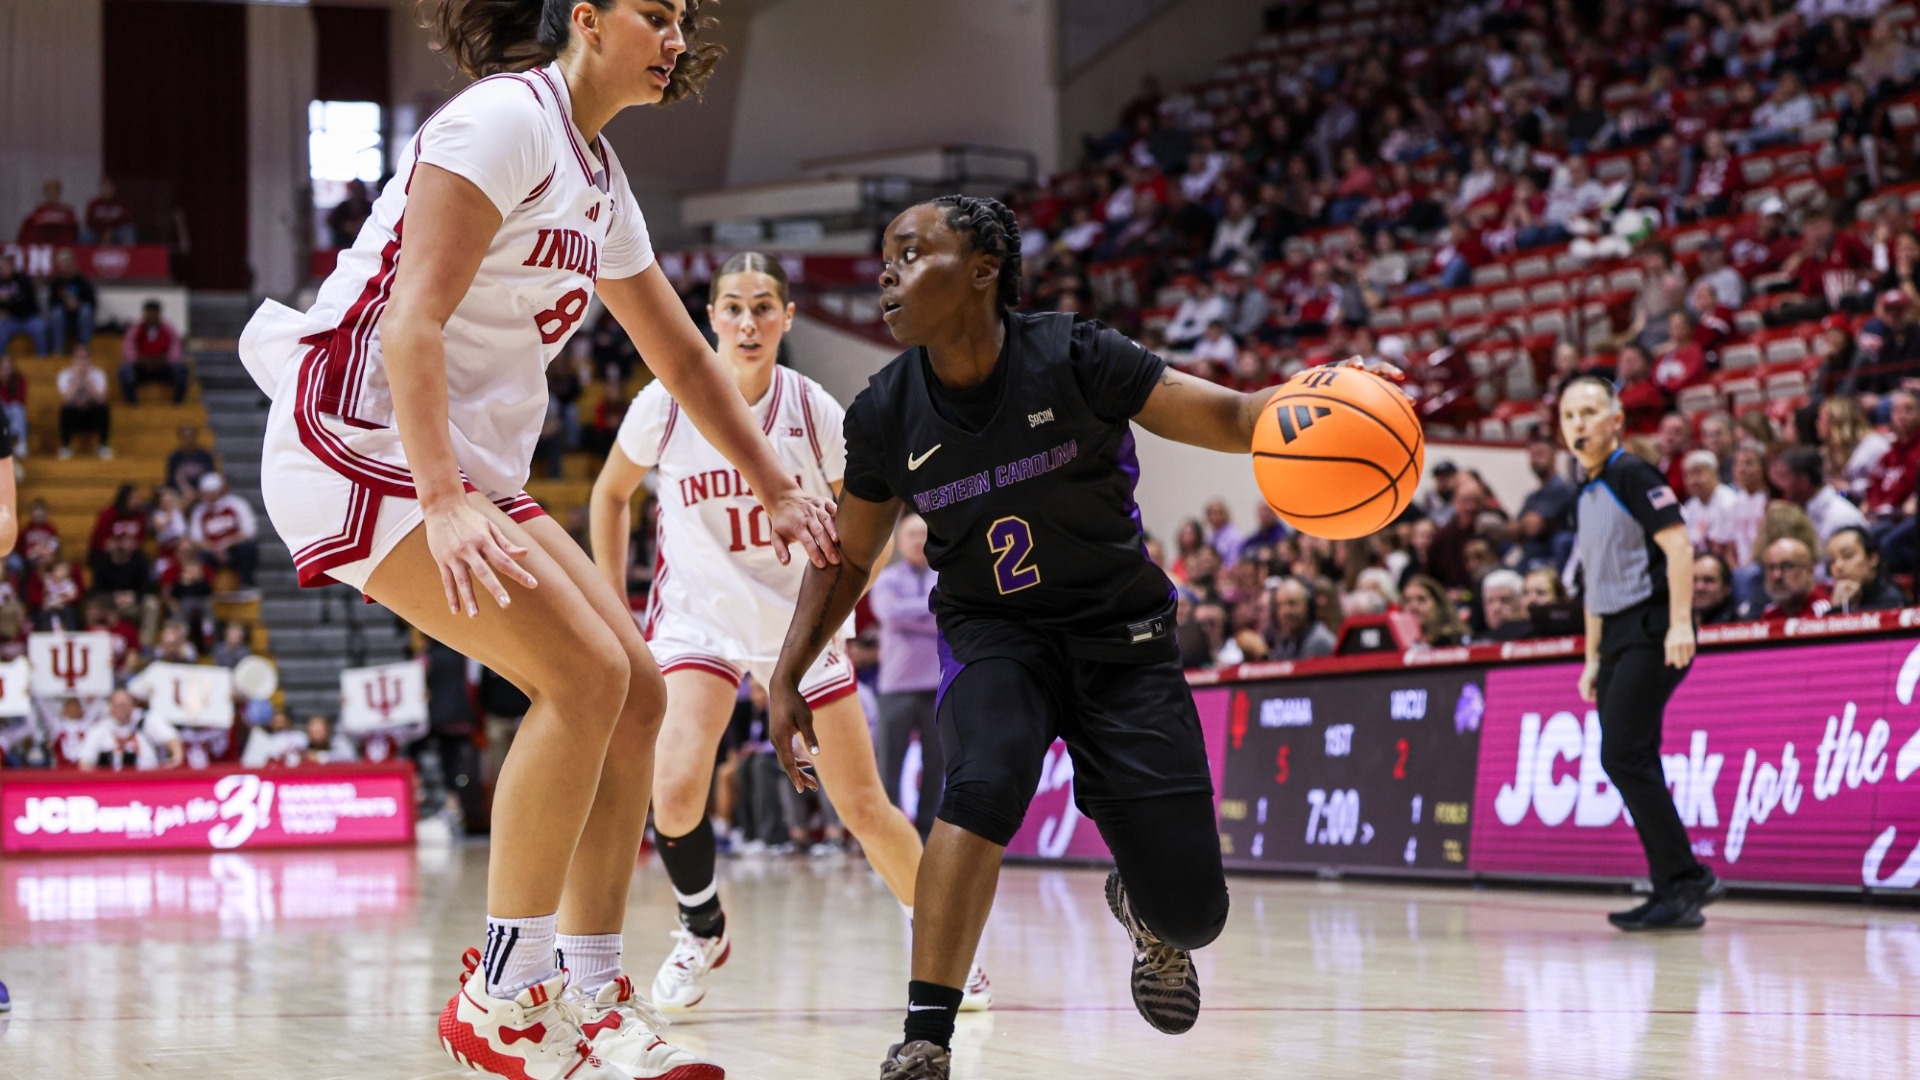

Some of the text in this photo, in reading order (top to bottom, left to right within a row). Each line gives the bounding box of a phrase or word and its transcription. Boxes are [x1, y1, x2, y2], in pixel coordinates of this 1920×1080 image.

[533, 286, 589, 344] 8
[913, 438, 1078, 513] WESTERN CAROLINA
[725, 504, 773, 553] 10
[986, 515, 1041, 595] 2
[1390, 689, 1428, 720] WCU
[1275, 745, 1290, 785] 5
[1392, 738, 1410, 781] 2
[1495, 710, 1725, 828] JCBnk
[1723, 741, 1803, 864] for
[1813, 700, 1892, 802] the
[1305, 788, 1360, 845] 7:00
